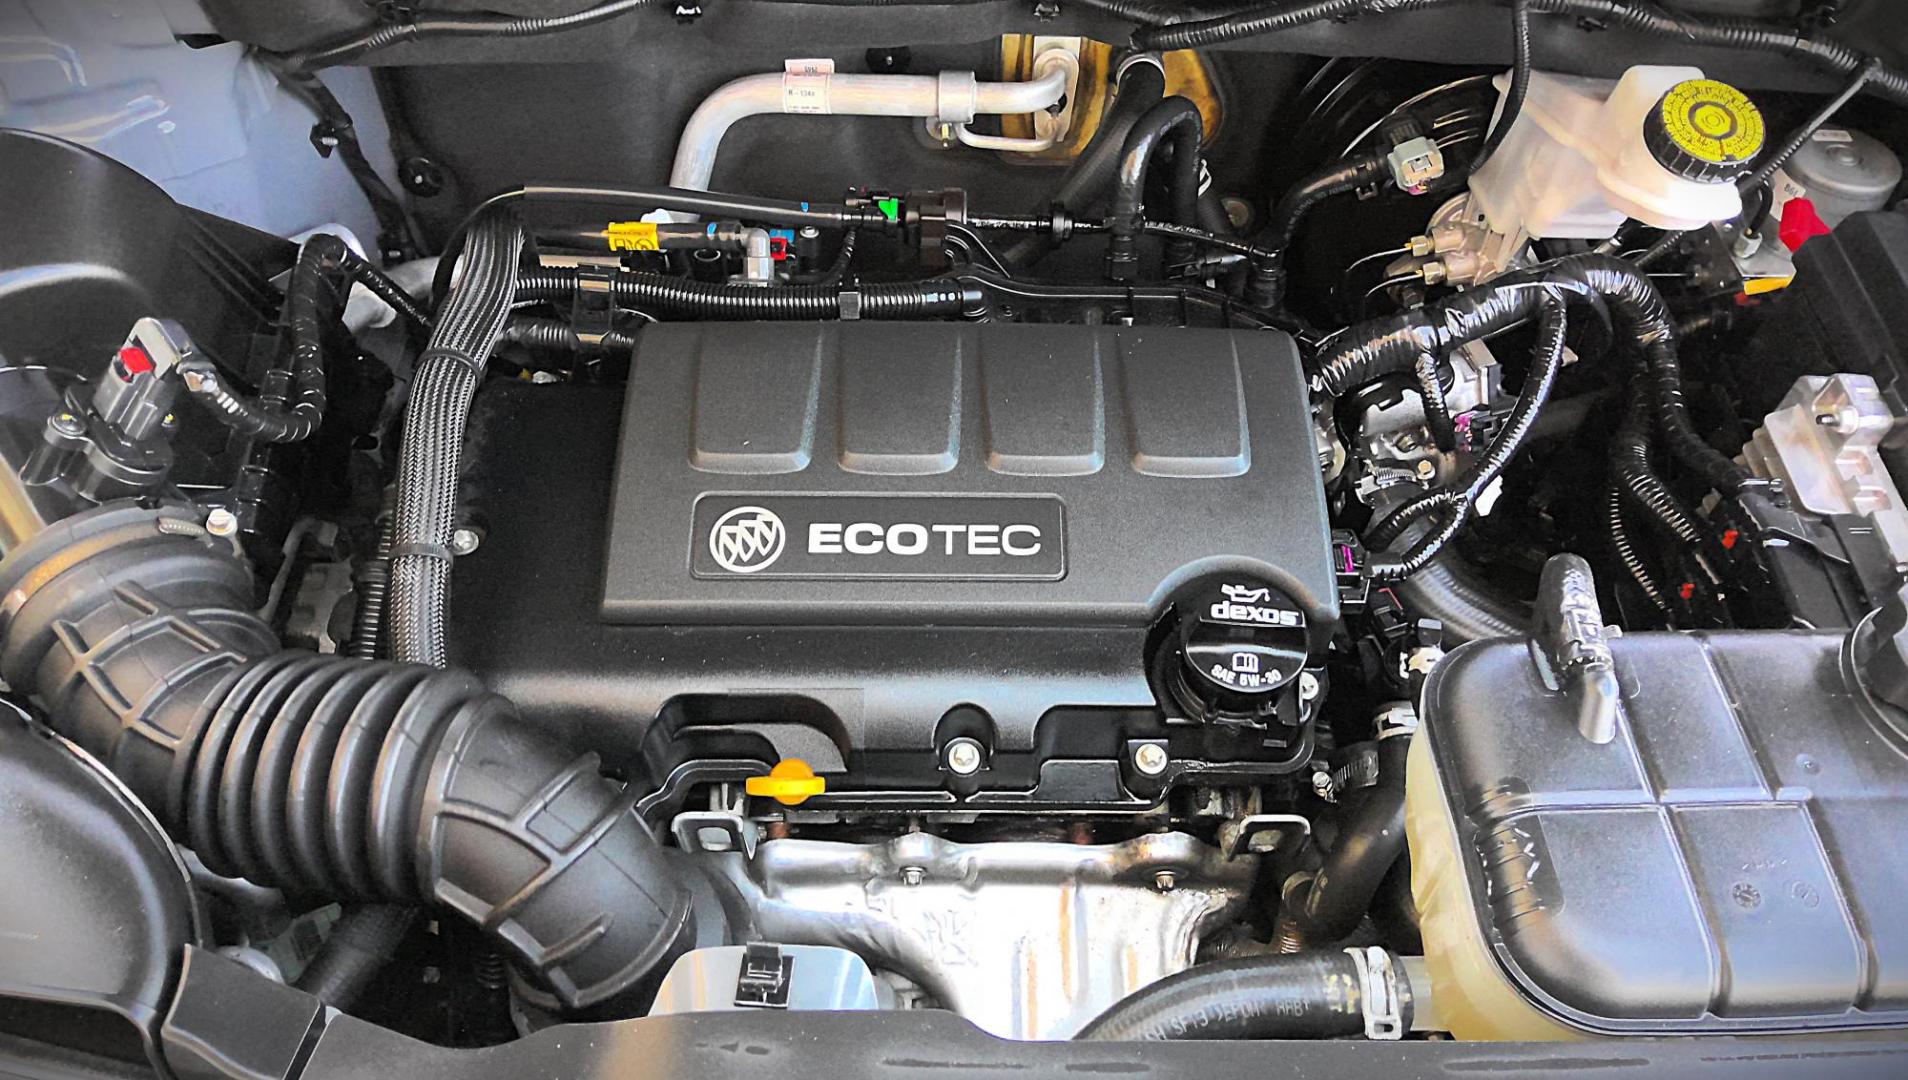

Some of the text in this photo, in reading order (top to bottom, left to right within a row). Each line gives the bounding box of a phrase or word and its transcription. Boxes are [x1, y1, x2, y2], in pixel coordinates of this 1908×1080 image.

[808, 523, 1042, 556] ECOTEC
[1211, 600, 1300, 626] dexos
[1211, 664, 1282, 688] SAE 5W-30
